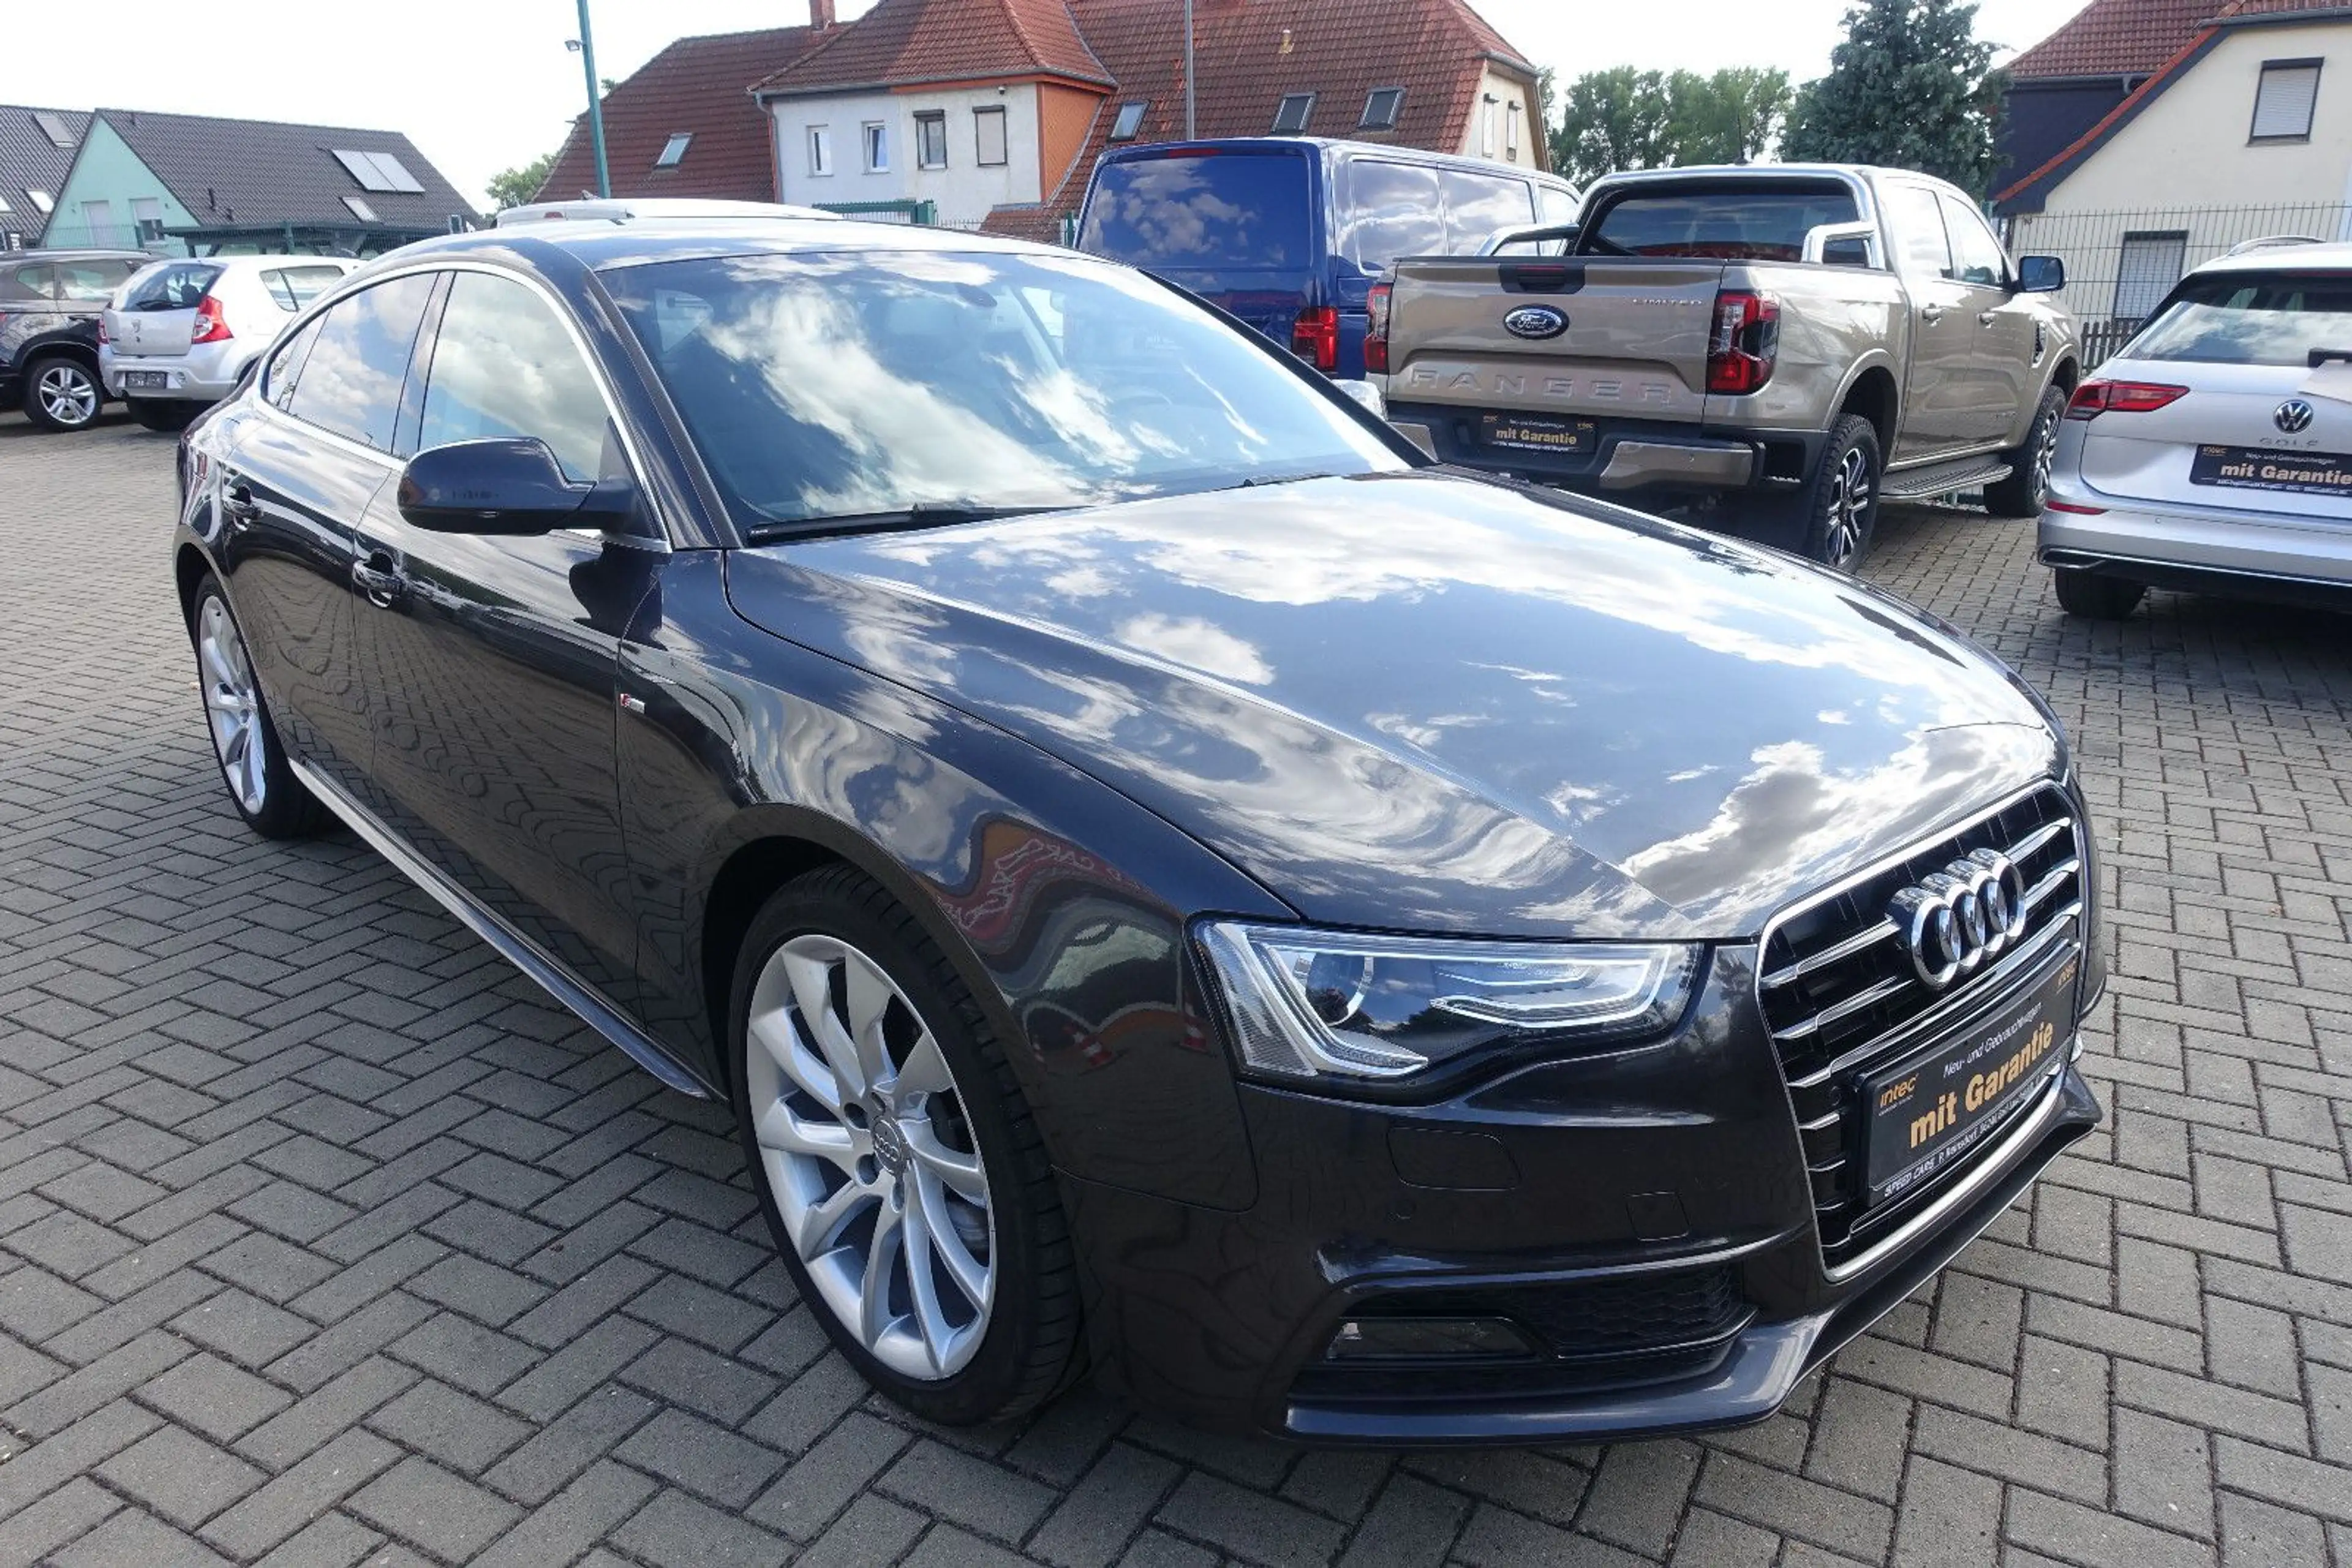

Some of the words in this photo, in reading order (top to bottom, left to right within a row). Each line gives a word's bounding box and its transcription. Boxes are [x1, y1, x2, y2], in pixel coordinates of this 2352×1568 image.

[1411, 369, 1673, 406] RANGER
[1496, 428, 1517, 439] mit
[1520, 429, 1577, 445] Garantie
[2260, 437, 2319, 448] GOLF
[2220, 463, 2255, 477] mit
[2261, 465, 2352, 484] Garantie
[1943, 1060, 1965, 1078] Neu-
[1968, 1045, 1984, 1063] und
[1880, 1076, 1917, 1108] intec
[1910, 1091, 1958, 1149] mit
[1965, 1021, 2054, 1112] Garantie
